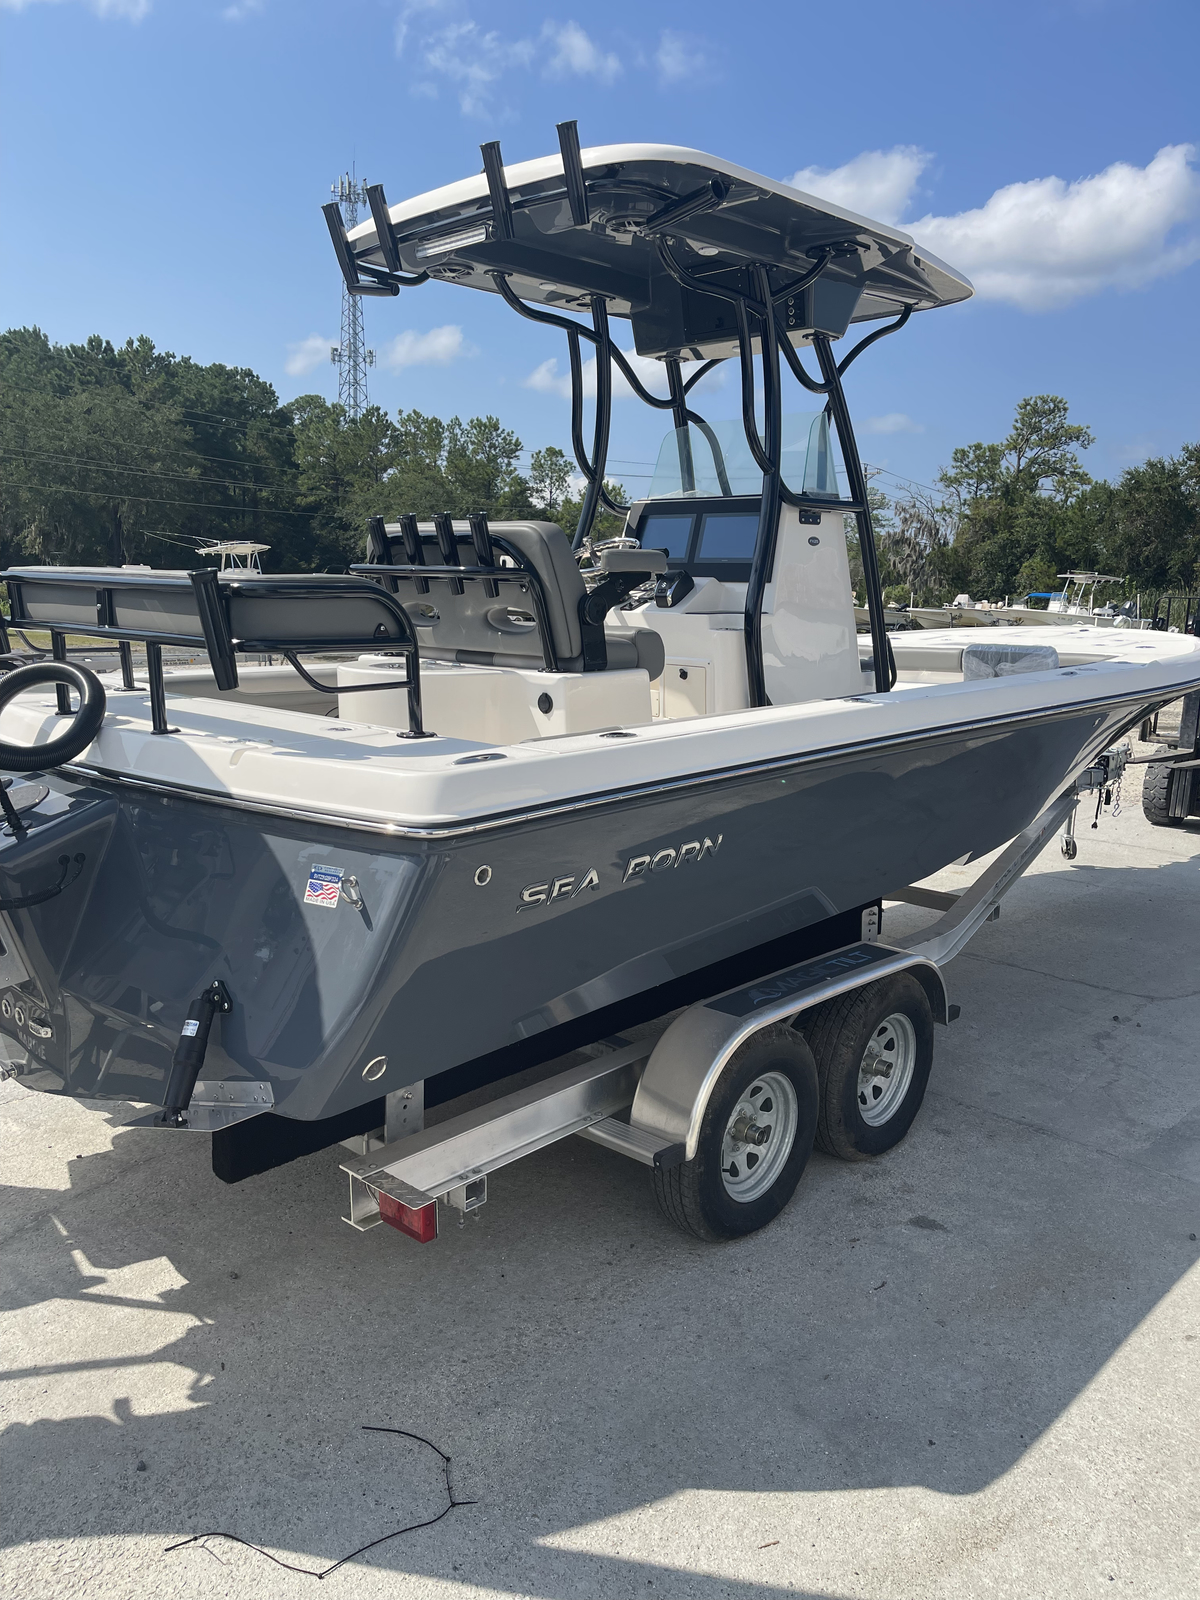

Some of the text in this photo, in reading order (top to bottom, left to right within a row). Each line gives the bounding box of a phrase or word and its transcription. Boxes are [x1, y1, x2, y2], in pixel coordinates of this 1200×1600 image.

[516, 833, 723, 914] SEA BORN
[305, 896, 319, 904] MADE
